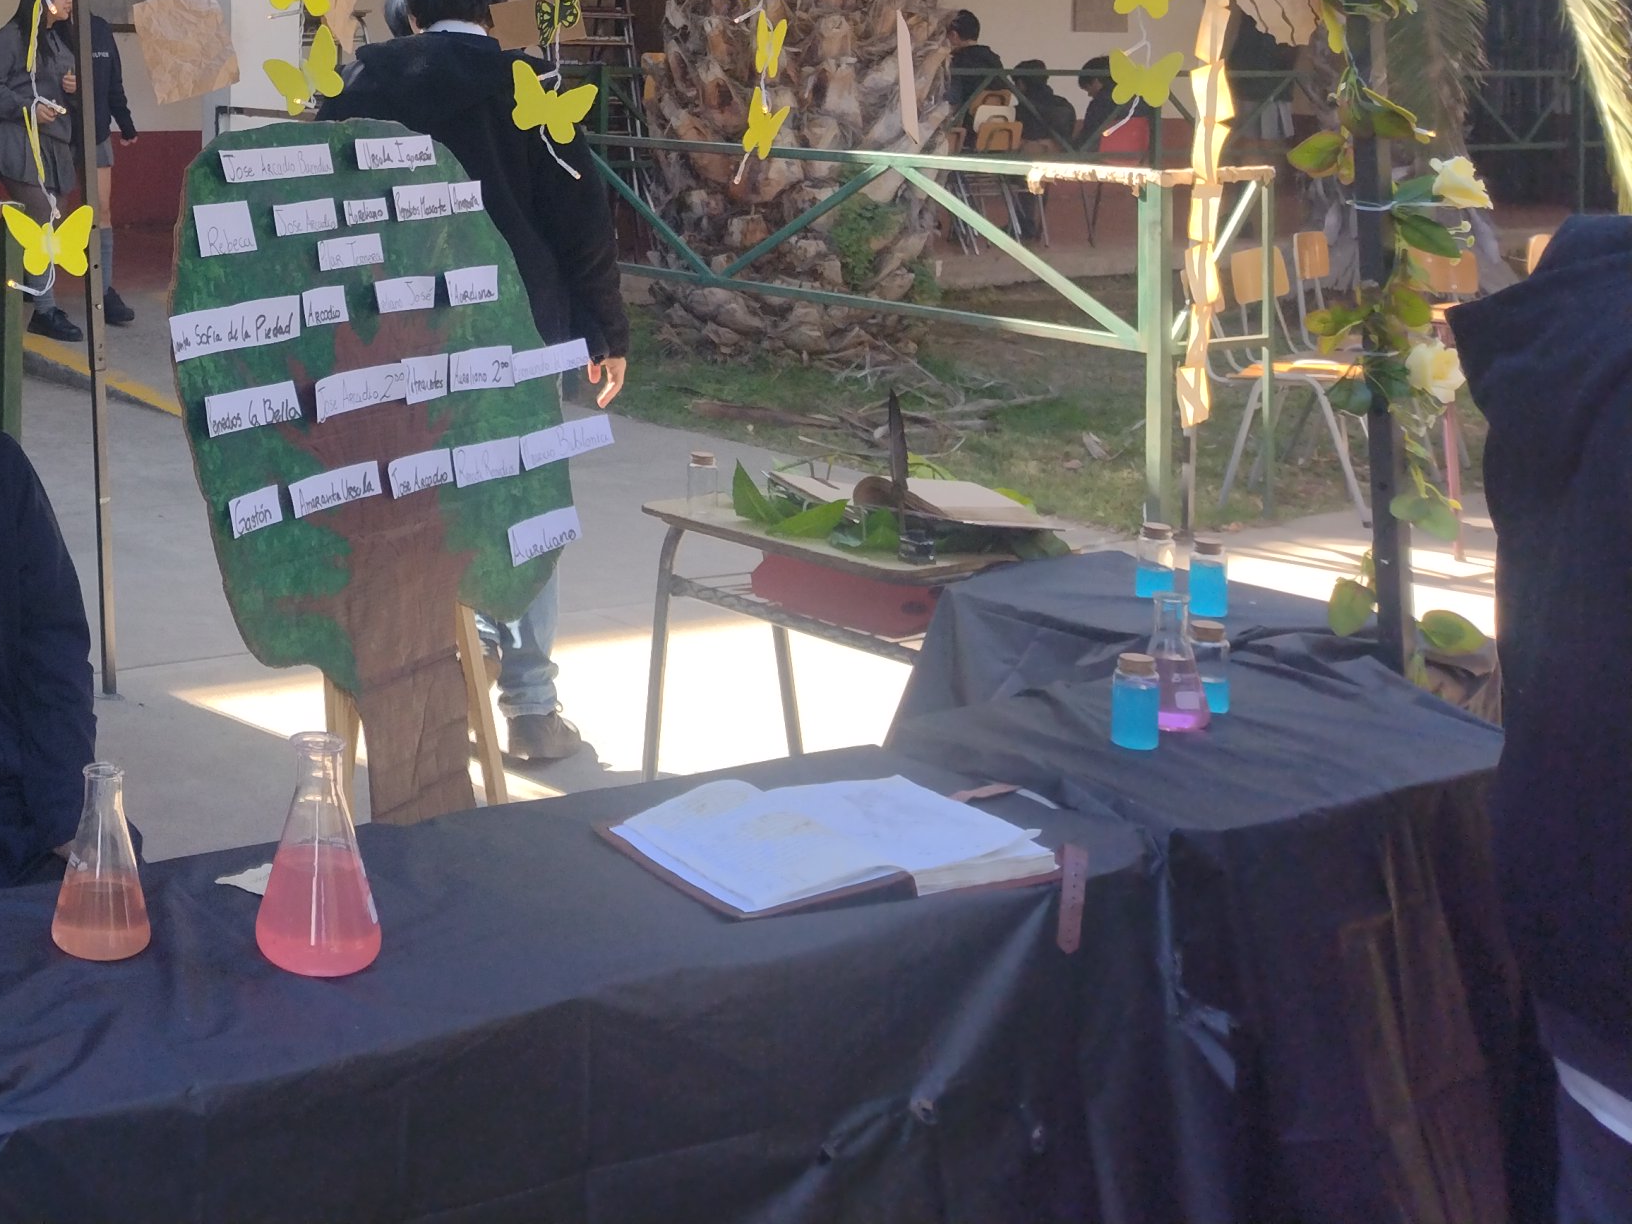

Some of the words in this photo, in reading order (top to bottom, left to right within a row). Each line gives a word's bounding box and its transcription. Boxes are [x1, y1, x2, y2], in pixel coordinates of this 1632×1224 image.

[207, 226, 255, 257] Rebeca
[405, 281, 434, 306] José
[227, 320, 239, 342] de
[263, 397, 302, 425] Bella
[234, 499, 274, 536] Gastón
[511, 527, 577, 566] Aureliano
